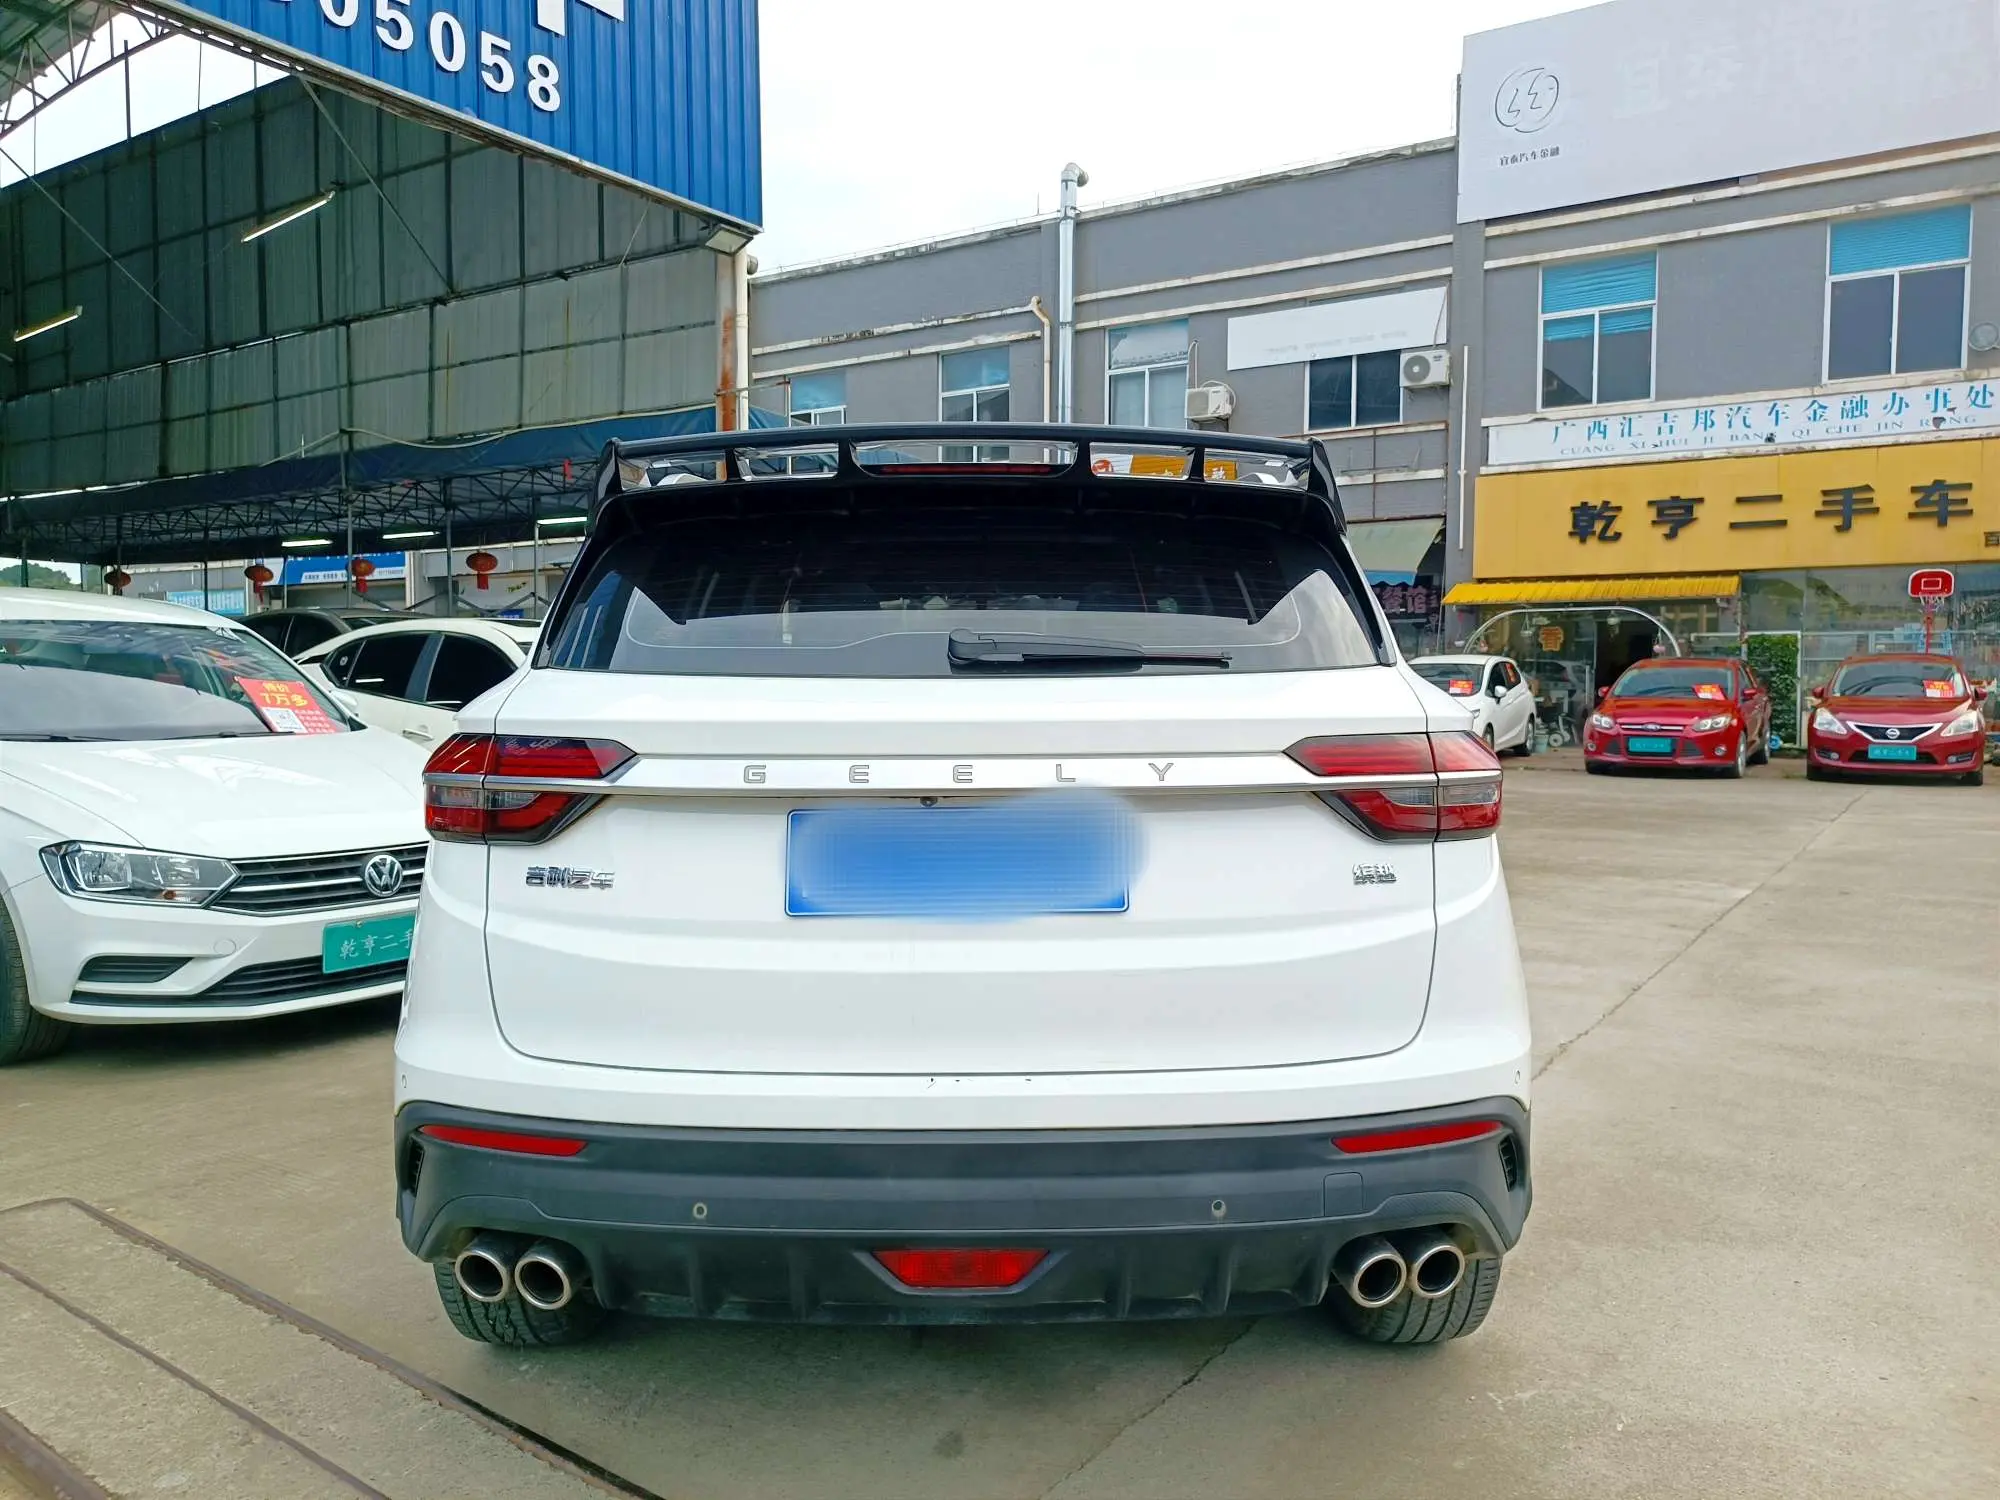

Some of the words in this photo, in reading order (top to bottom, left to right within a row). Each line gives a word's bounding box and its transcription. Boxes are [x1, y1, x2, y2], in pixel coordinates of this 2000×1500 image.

[1919, 414, 1978, 429] RNG
[1568, 479, 1974, 543] 乾亨二手车
[743, 762, 1175, 784] GEELY
[526, 866, 615, 890] 吉利汽车
